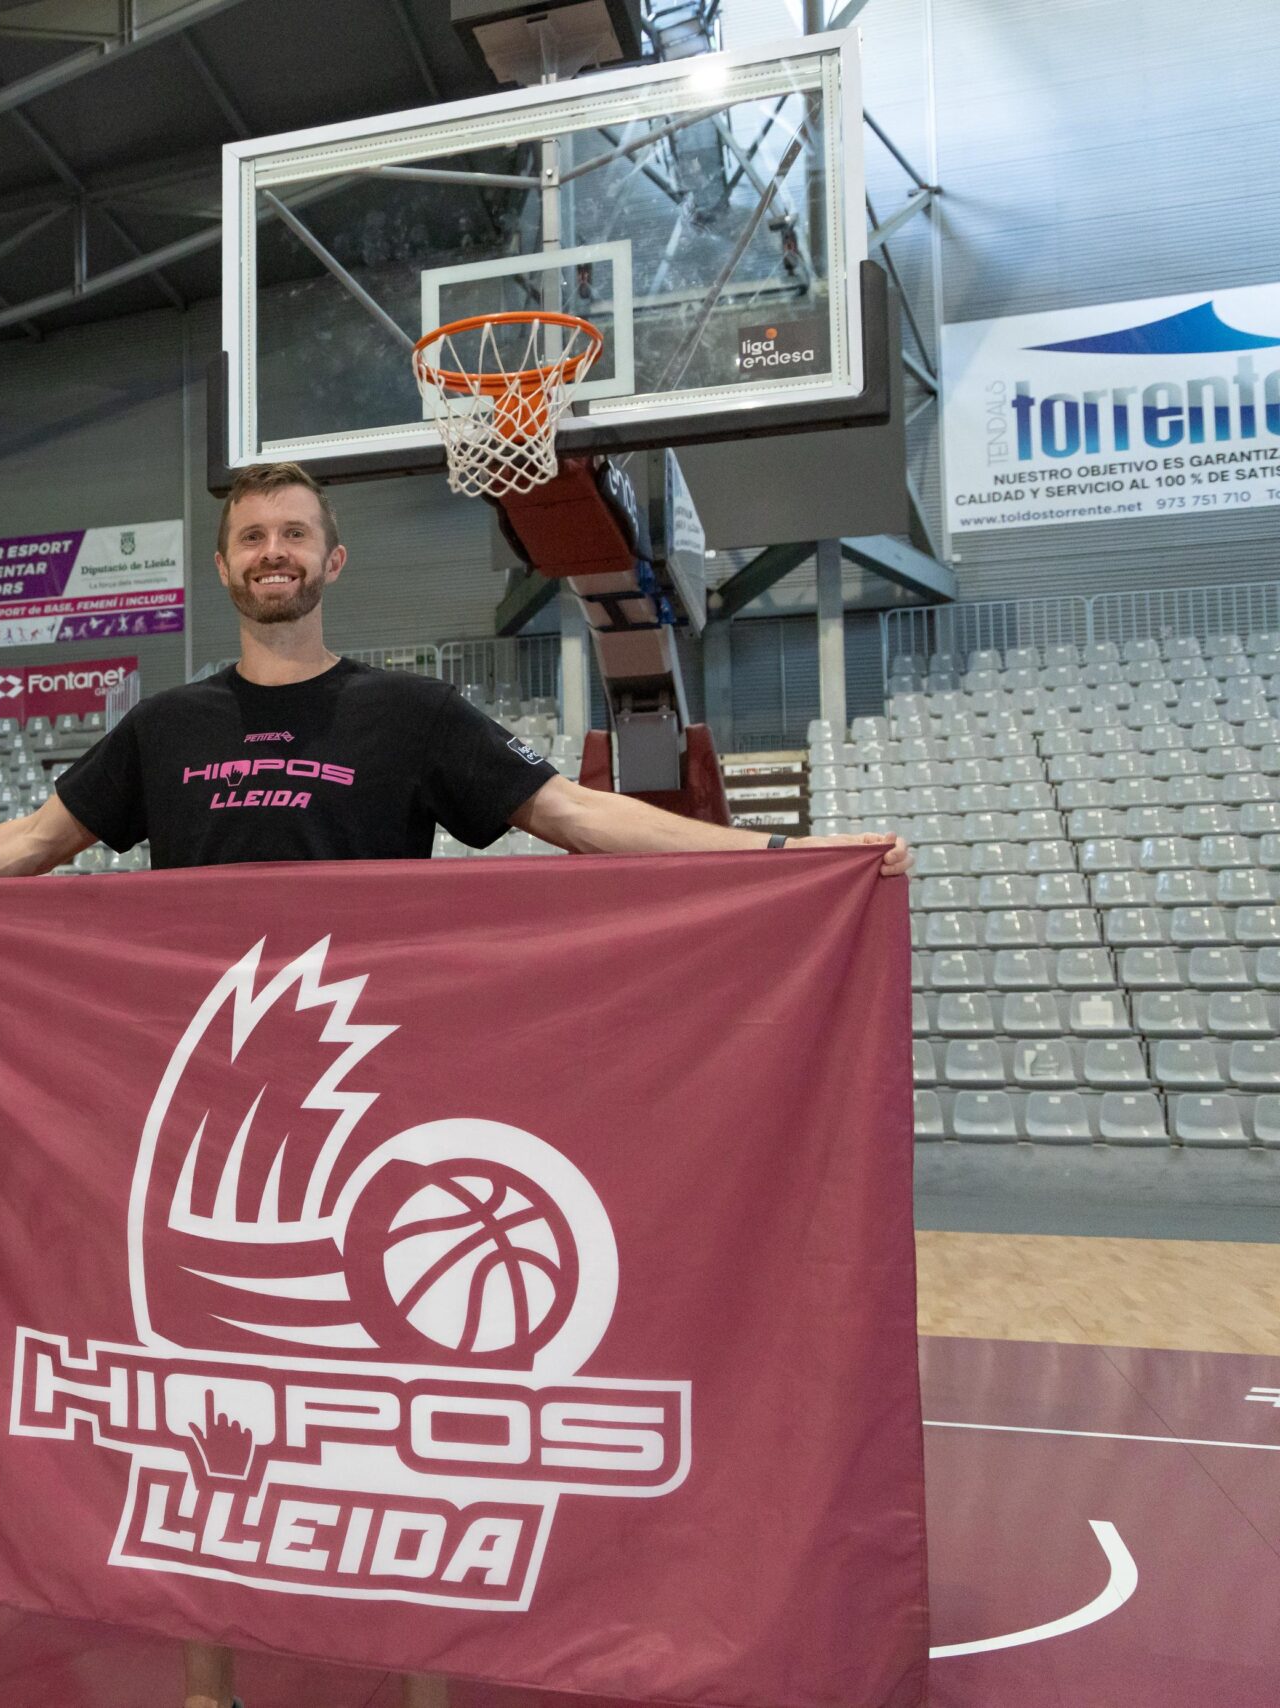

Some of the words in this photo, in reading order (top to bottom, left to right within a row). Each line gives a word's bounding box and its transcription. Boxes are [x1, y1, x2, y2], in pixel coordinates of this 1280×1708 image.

[741, 340, 775, 356] liga
[742, 349, 815, 369] endesa
[993, 467, 1073, 486] NUESTRO
[1077, 459, 1158, 478] OBJETIVO
[1163, 456, 1184, 470] ES
[1189, 447, 1280, 468] GARANTIZ
[955, 489, 1025, 506] CALIDAD
[1030, 487, 1042, 499] Y
[1045, 479, 1125, 498] SERVICIO
[1129, 476, 1150, 490] AL
[1157, 474, 1186, 488] 100
[1207, 469, 1230, 483] DE
[959, 501, 1143, 527] www.toldostorrente.net
[1156, 498, 1186, 511] 973
[1192, 494, 1218, 507] 751
[1223, 491, 1252, 504] 710
[6, 540, 73, 558] ESPORT
[81, 563, 128, 576] Diputació
[130, 561, 142, 570] de
[144, 557, 176, 569] Lleida
[28, 666, 126, 694] Fontanet
[209, 790, 312, 809] LLEIDA
[139, 1483, 523, 1585] LLEIDA
